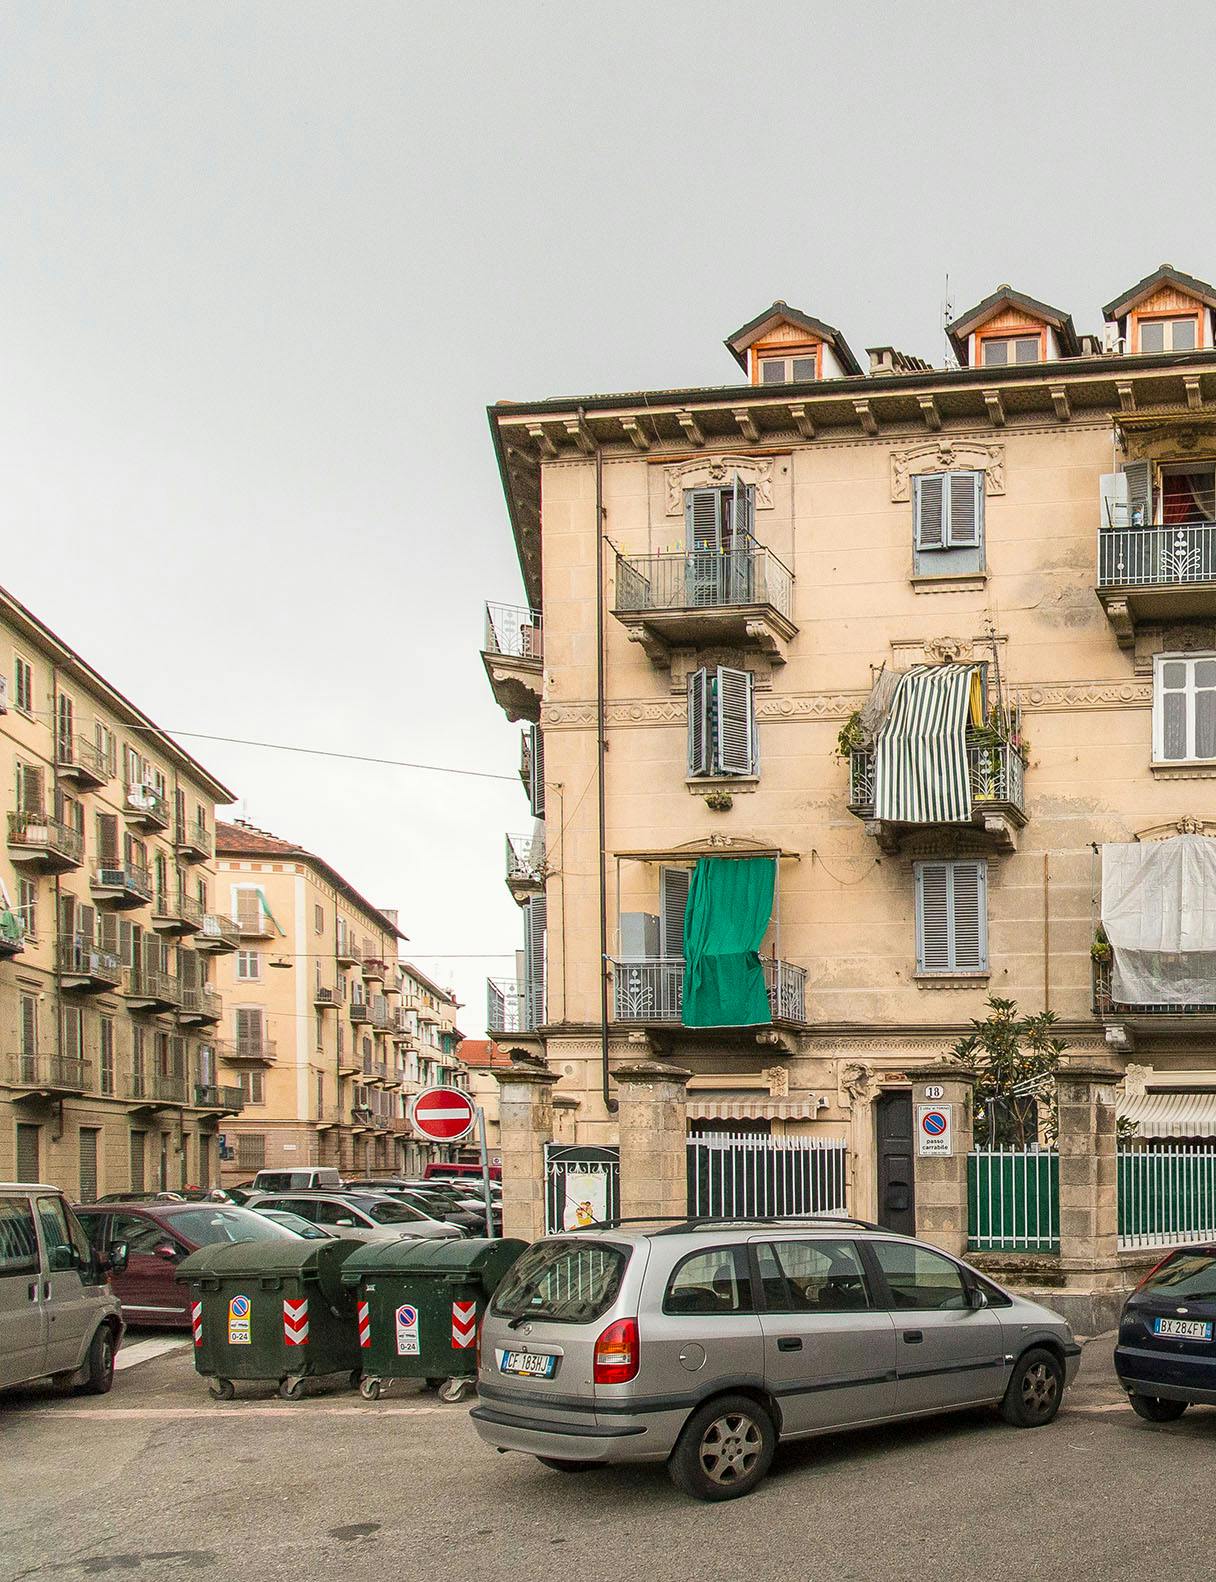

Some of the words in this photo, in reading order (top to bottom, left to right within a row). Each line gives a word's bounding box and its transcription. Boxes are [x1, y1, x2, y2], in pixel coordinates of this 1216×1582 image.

[928, 1087, 940, 1097] 18
[1161, 1320, 1172, 1332] BX
[1175, 1321, 1205, 1336] 284FY
[400, 1343, 416, 1351] 0-24
[508, 1353, 519, 1368] CF
[522, 1355, 548, 1371] 183HJ
